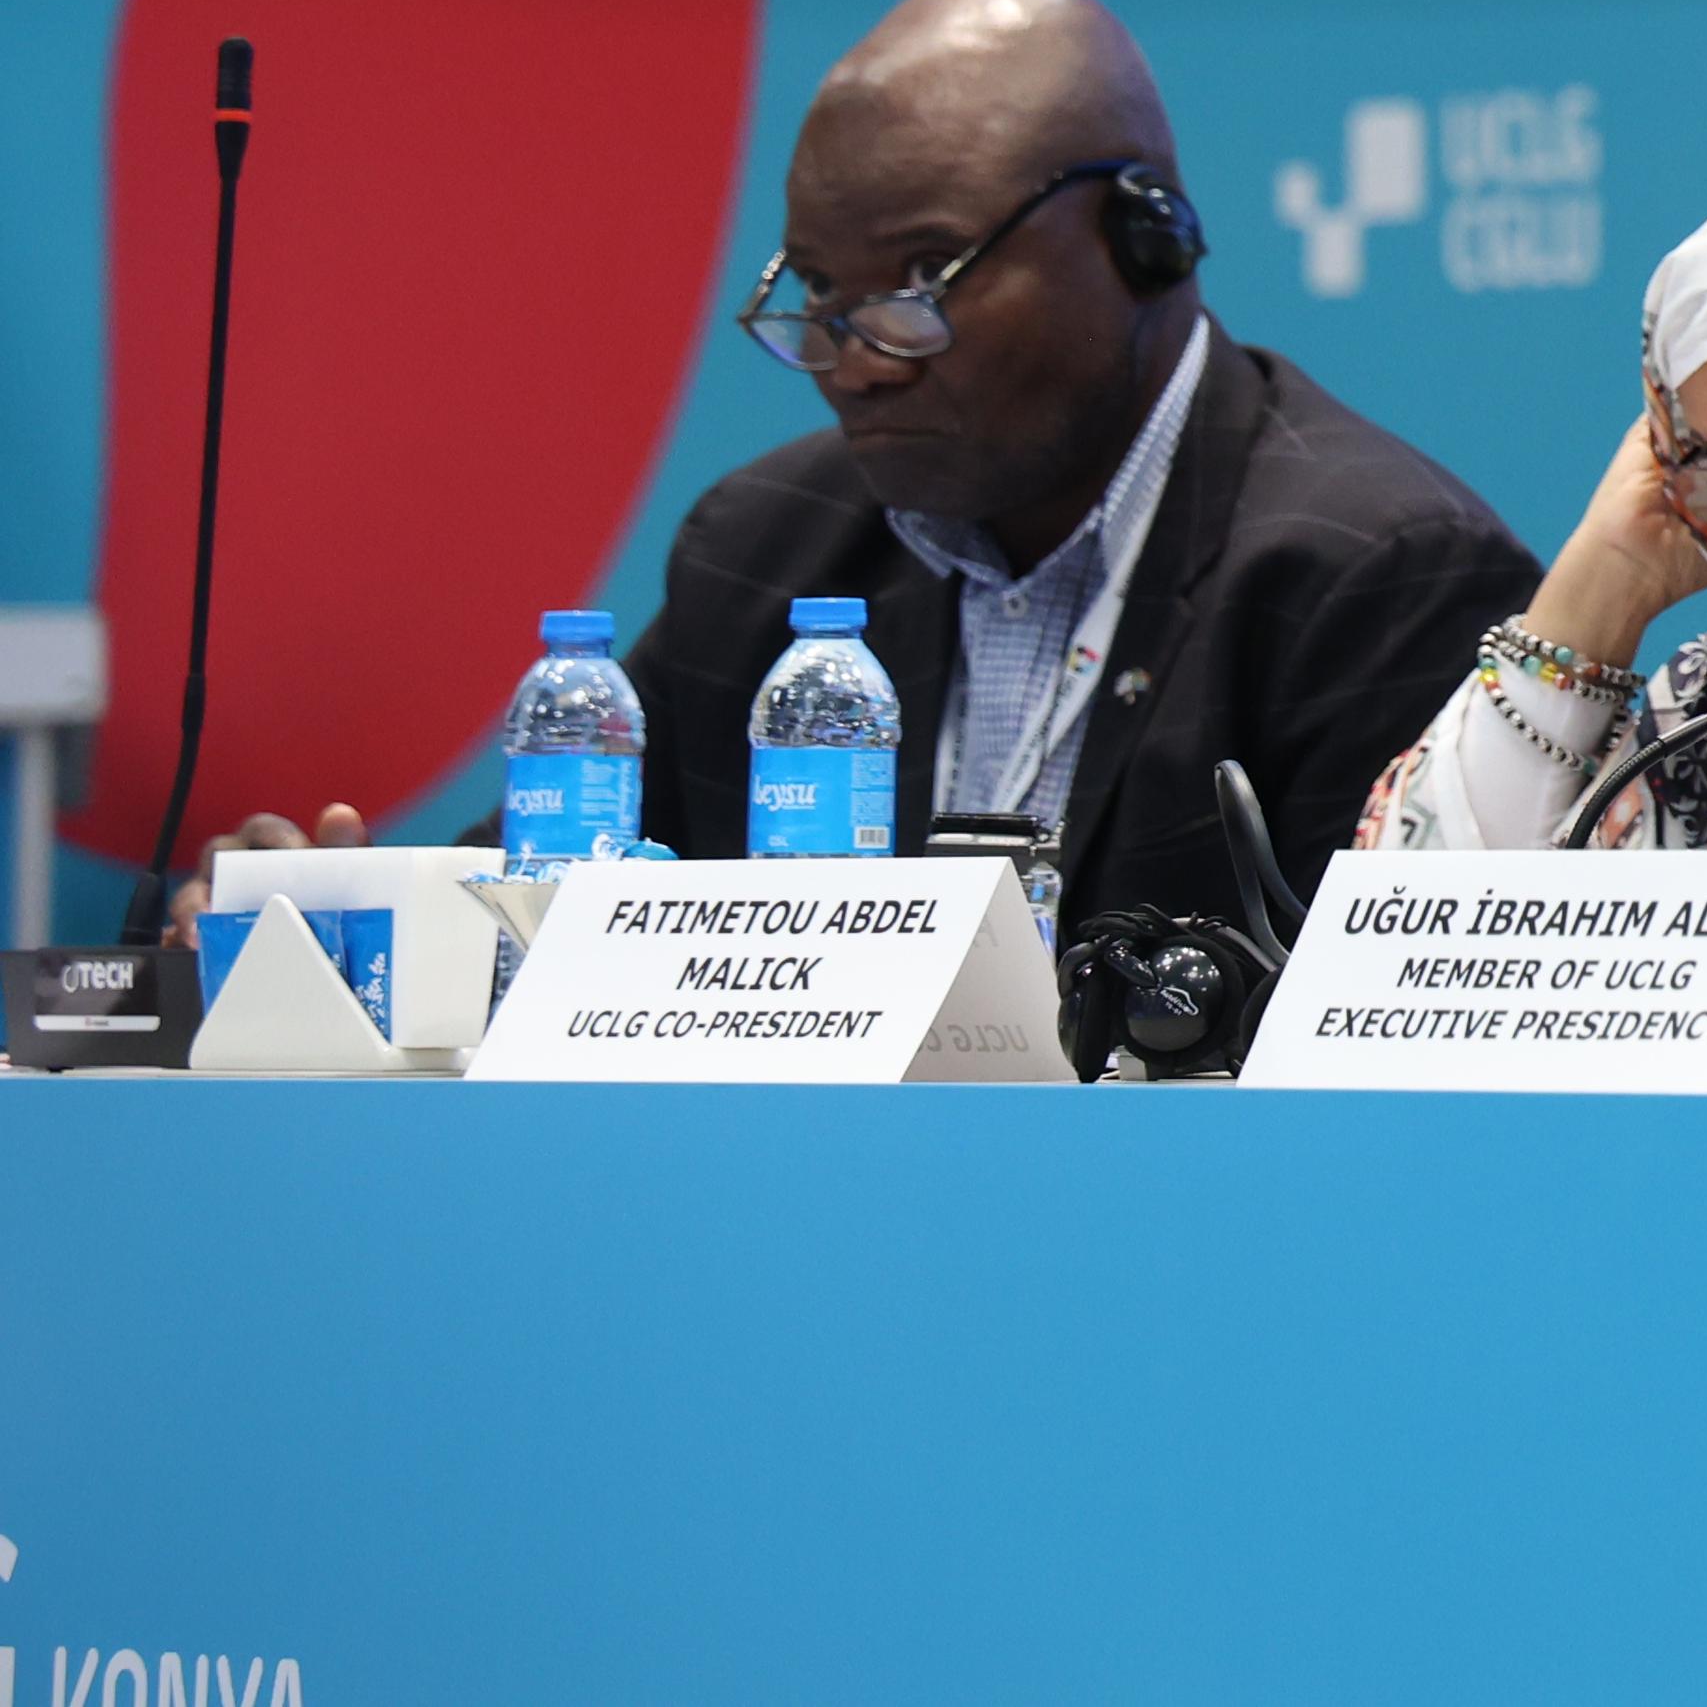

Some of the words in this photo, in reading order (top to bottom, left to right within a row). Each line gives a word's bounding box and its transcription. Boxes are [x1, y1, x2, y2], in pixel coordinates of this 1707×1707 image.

[605, 899, 820, 935] FATIMETOU
[820, 899, 938, 935] ABDEL
[1344, 885, 1459, 936] UĞUR
[676, 956, 823, 991] MALICK
[1396, 957, 1543, 990] MEMBER
[1549, 959, 1600, 991] OF
[1604, 959, 1697, 991] UCLG
[567, 1010, 650, 1039] UCLG
[653, 1010, 884, 1039] CO-PRESIDENT
[1315, 1007, 1509, 1040] EXECUTIVE
